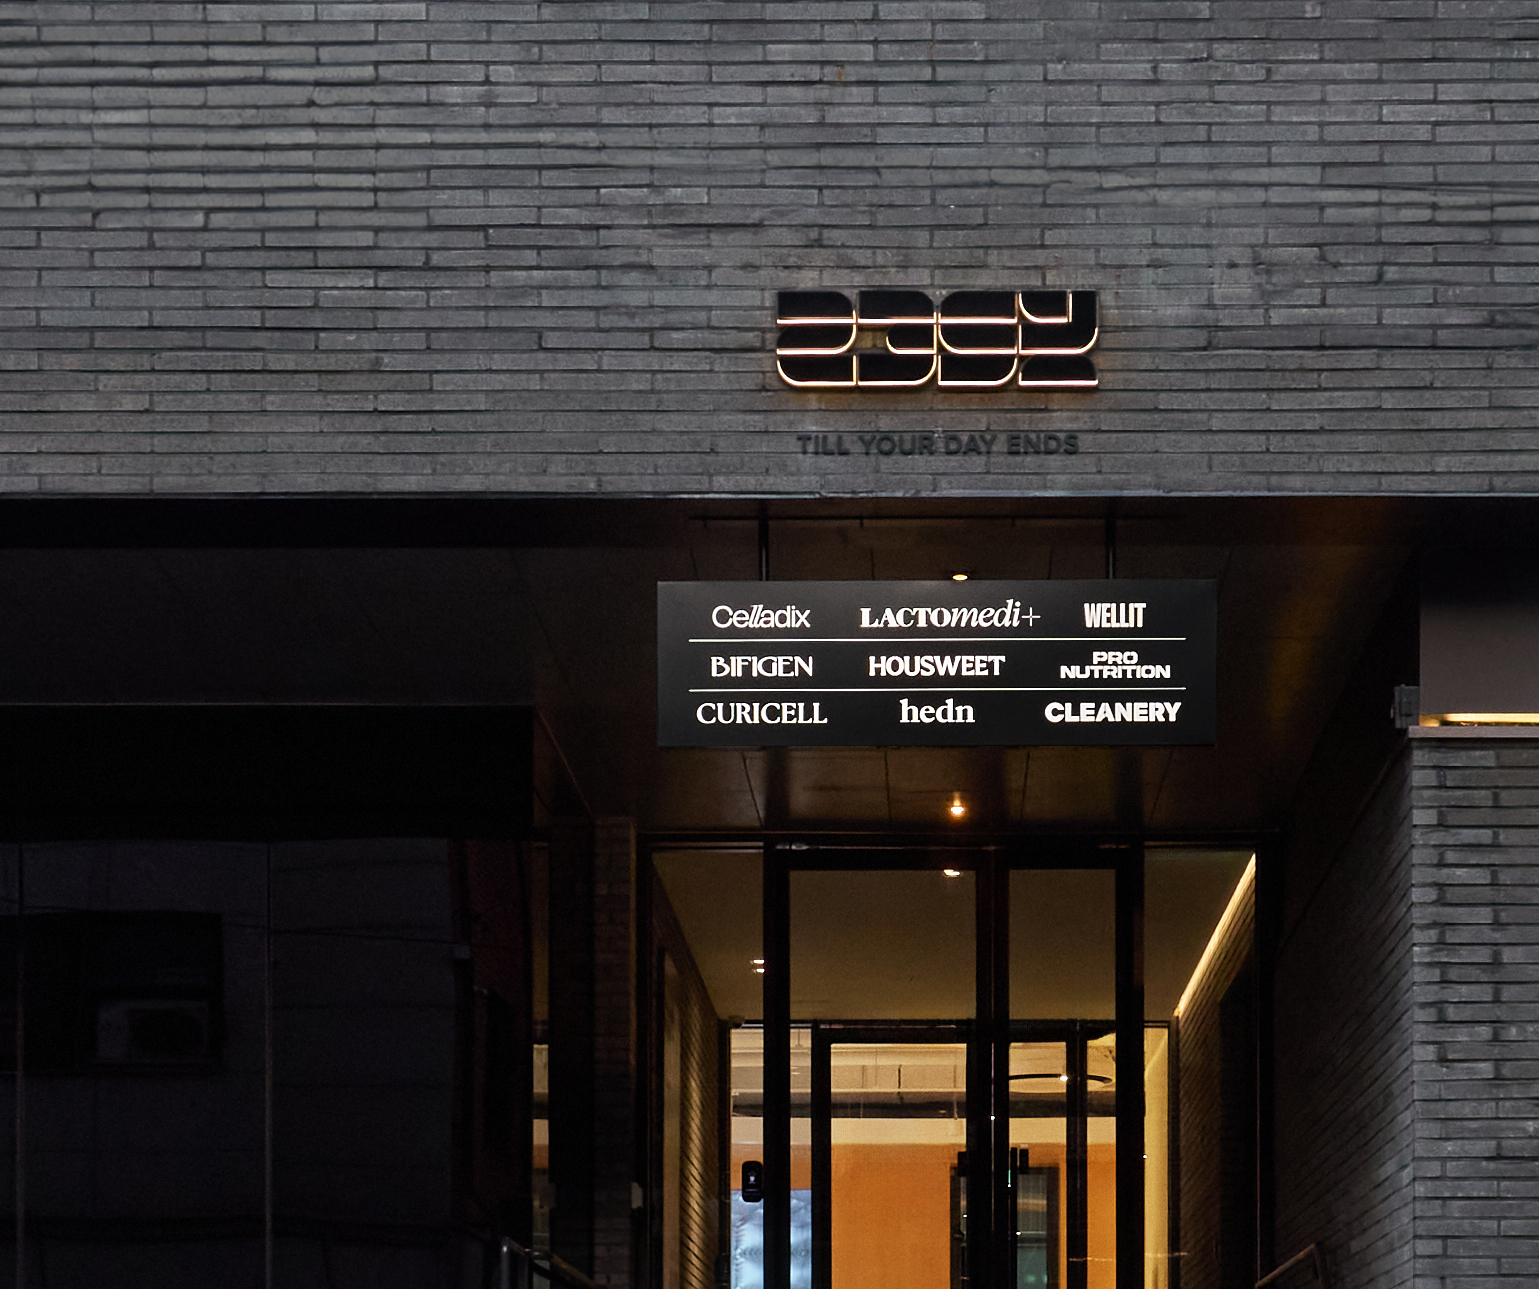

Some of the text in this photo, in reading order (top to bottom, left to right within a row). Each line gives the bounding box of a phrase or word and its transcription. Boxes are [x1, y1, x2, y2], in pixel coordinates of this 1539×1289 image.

[797, 435, 1080, 455] TILL YOUR DAY ENDS
[711, 604, 811, 629] Celladix
[1083, 602, 1147, 628] WELLIT
[710, 656, 814, 678] BIFIGEN
[868, 655, 1006, 677] HOUSWEET
[1092, 650, 1139, 665] PRO
[1059, 664, 1171, 679] NUTRITION
[696, 702, 828, 725] CURICELL
[899, 698, 976, 724] hedn
[1044, 701, 1182, 723] CLEANERY
